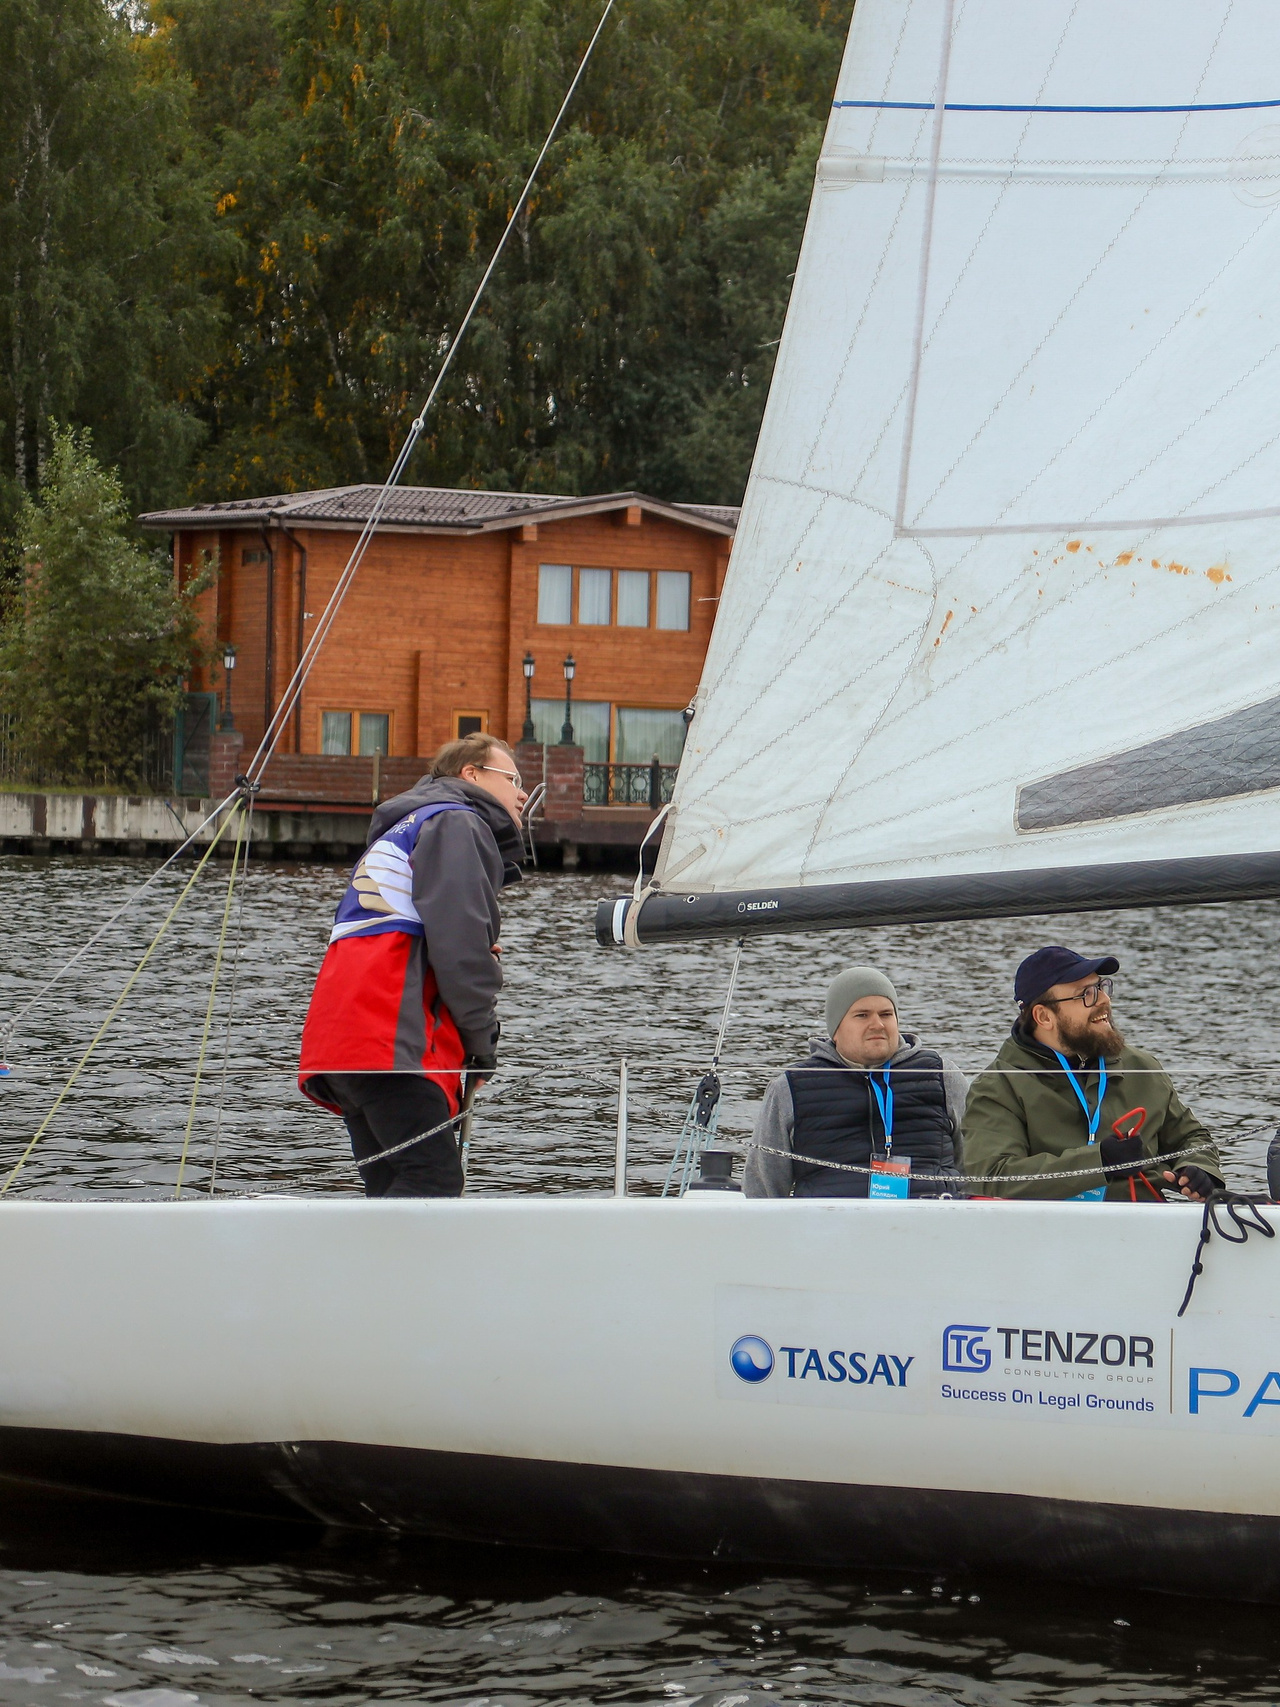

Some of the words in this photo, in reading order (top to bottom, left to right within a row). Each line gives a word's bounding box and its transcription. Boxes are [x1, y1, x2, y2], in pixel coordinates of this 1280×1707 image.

[746, 900, 779, 911] SELDÉN
[997, 1327, 1155, 1369] TENZOR
[779, 1346, 916, 1388] TASSAY
[1003, 1368, 1096, 1381] CONSULTING
[1106, 1374, 1155, 1384] GROUP
[941, 1384, 1007, 1402] Success
[1012, 1389, 1033, 1404] On
[1039, 1391, 1081, 1410] Legal
[1086, 1394, 1155, 1412] Grounds
